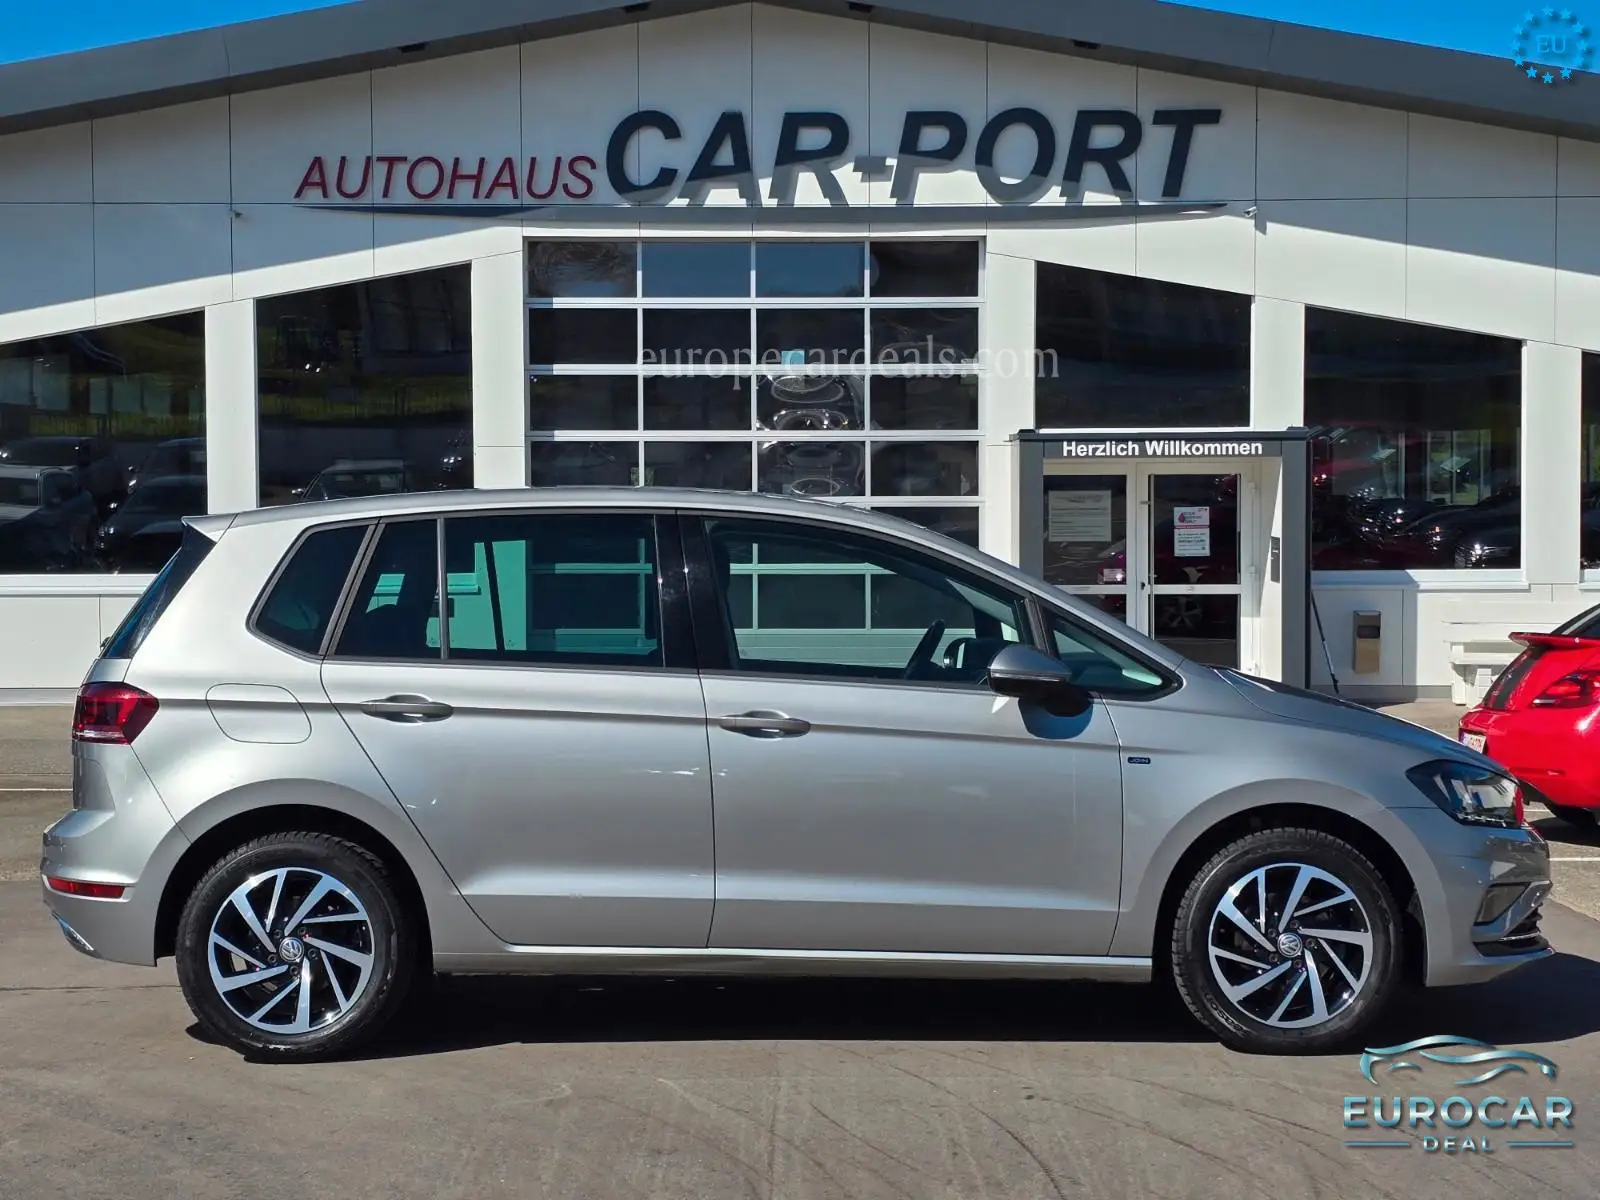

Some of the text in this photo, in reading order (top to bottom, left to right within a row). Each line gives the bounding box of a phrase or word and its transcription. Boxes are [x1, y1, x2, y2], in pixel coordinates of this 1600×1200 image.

[294, 107, 1222, 204] AUTOHAUS CAR-PORT
[1062, 440, 1263, 457] Herzlich Willkommen
